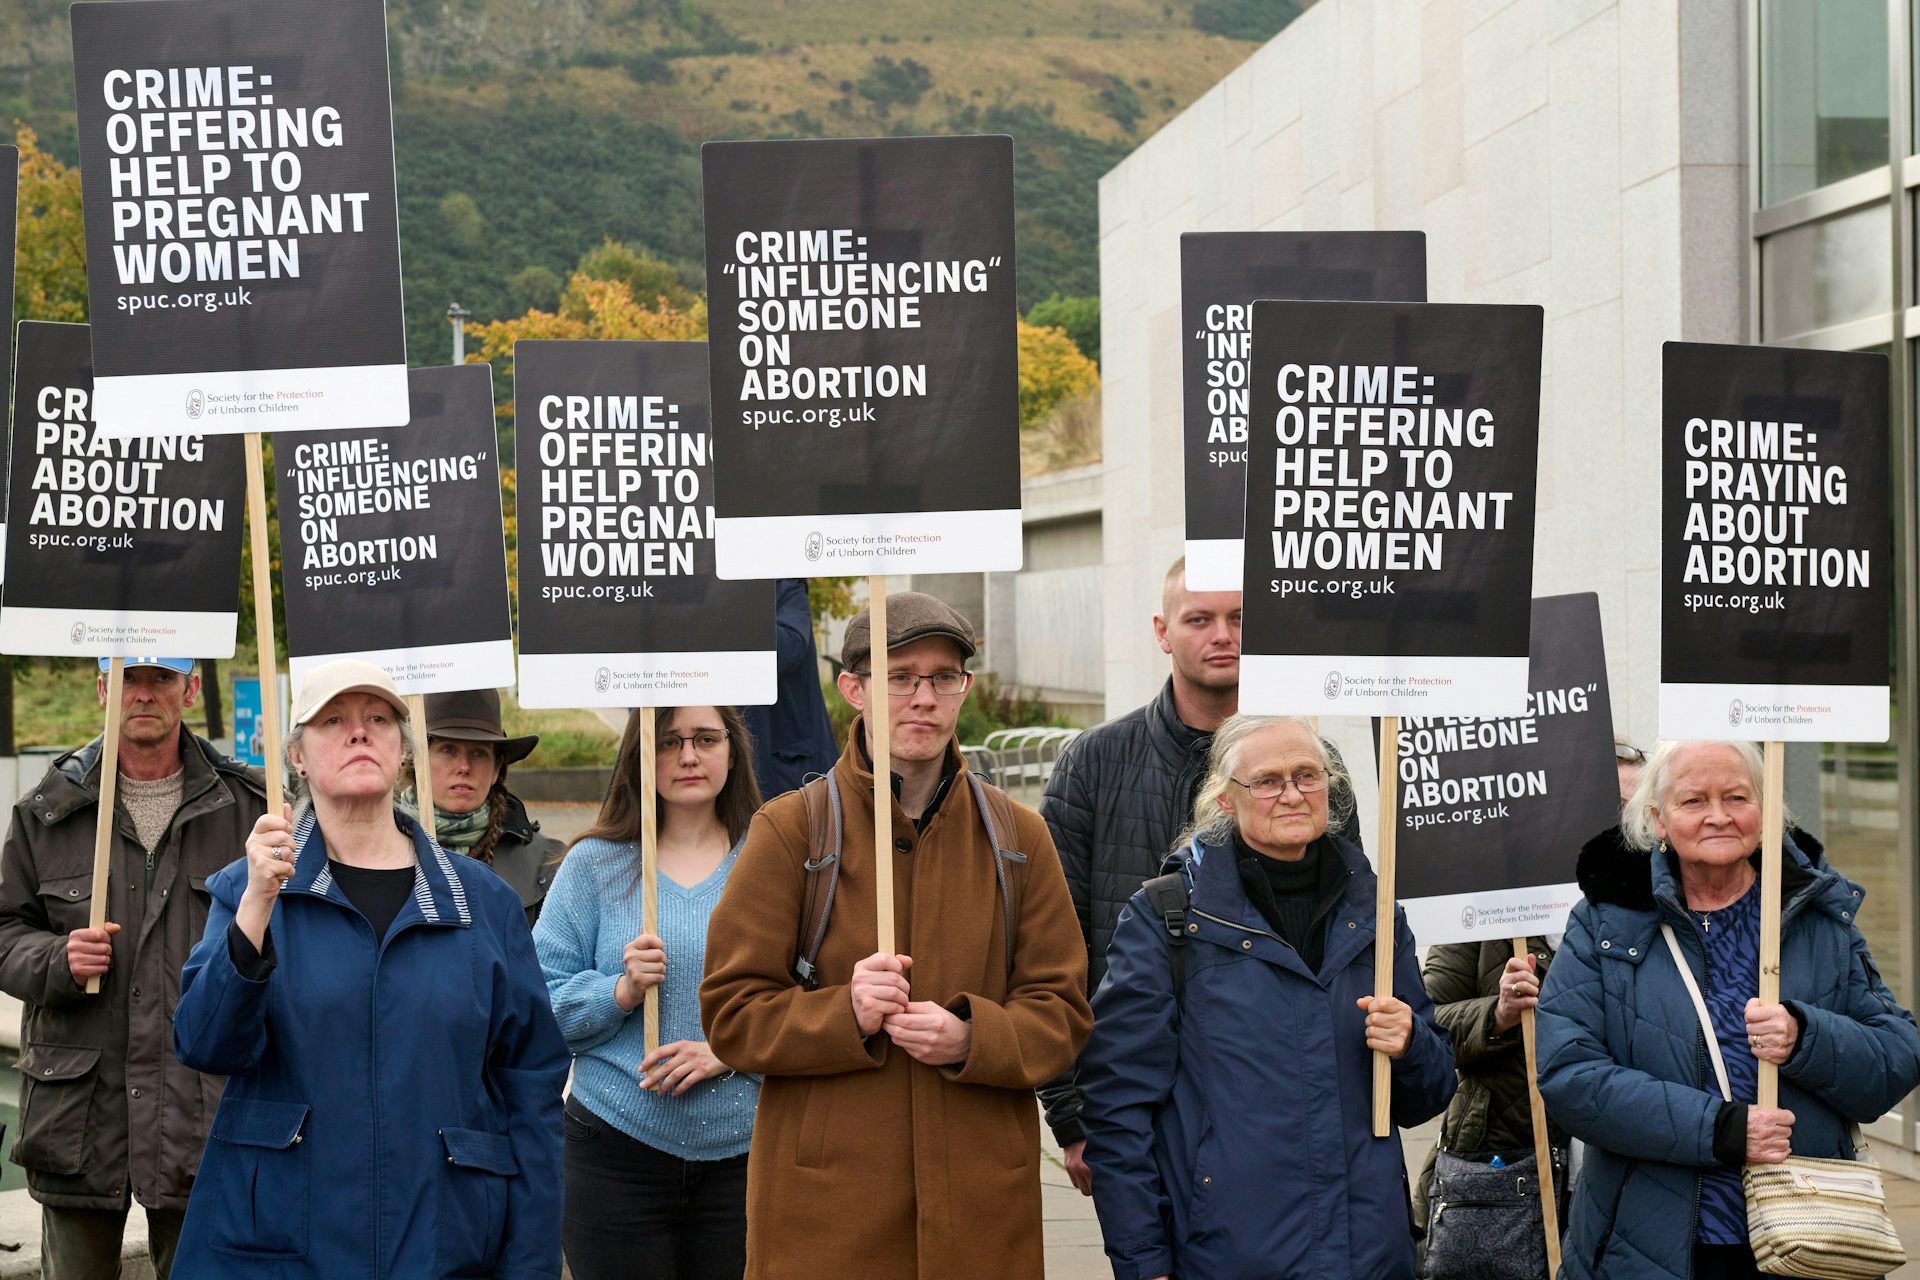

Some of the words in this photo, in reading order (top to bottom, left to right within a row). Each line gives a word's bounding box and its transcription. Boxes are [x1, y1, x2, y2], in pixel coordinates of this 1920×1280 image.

[104, 66, 273, 110] CRIME:
[106, 106, 343, 154] OFFERING
[110, 154, 231, 197] HELP
[243, 151, 301, 192] TO
[113, 193, 369, 241] PREGNANT
[113, 239, 299, 284] WOMEN
[736, 230, 867, 264] CRIME:
[118, 286, 252, 315] spuc.org.uk
[738, 297, 921, 333] SOMEONE
[740, 334, 790, 367] ON
[207, 393, 240, 403] Society
[244, 392, 256, 401] for
[260, 392, 274, 400] the
[276, 390, 323, 399] Protection
[740, 365, 926, 400] ABORTION
[1277, 364, 1434, 404] CRIME:
[208, 406, 217, 415] of
[220, 405, 256, 414] Unborn
[259, 403, 298, 412] Children
[539, 395, 678, 430] CRIME:
[743, 402, 876, 430] spuc.org.uk
[1276, 406, 1494, 447] OFFERING
[1685, 418, 1816, 461] CRIME:
[295, 438, 389, 469] CRIME:
[539, 432, 713, 467] OFFERIN
[32, 458, 163, 494] ABOUT
[1276, 448, 1388, 487] HELP
[1400, 450, 1452, 488] TO
[1686, 461, 1847, 505] PRAYING
[299, 485, 430, 519] SOMEONE
[542, 469, 641, 503] HELP
[652, 469, 699, 503] TO
[30, 493, 224, 531] ABORTION
[1274, 490, 1512, 529] PREGNANT
[1684, 503, 1809, 544] ABOUT
[30, 533, 133, 551] spuc.org.uk
[301, 518, 338, 544] ON
[827, 536, 859, 545] Society
[862, 535, 875, 544] for
[877, 535, 892, 543] the
[895, 533, 941, 543] Protection
[303, 535, 437, 569] ABORTION
[541, 542, 693, 577] WOMEN
[826, 548, 836, 557] of
[839, 548, 873, 557] Unborn
[877, 546, 916, 556] Children
[1272, 531, 1442, 570] WOMEN
[1683, 545, 1869, 587] ABORTION
[306, 565, 401, 590] spuc.org.uk
[542, 581, 653, 603] spuc.org.uk
[1271, 576, 1395, 599] spuc.org.uk
[1684, 591, 1784, 613] spuc.org.uk
[88, 626, 113, 635] Society
[140, 627, 176, 635] Protection
[407, 663, 417, 671] the
[420, 661, 454, 670] Protection
[407, 672, 436, 680] Children
[613, 671, 640, 679] Society
[670, 670, 708, 678] Protection
[1344, 677, 1375, 686] Society
[1378, 677, 1390, 685] for
[1392, 677, 1406, 685] the
[1408, 677, 1452, 685] Protection
[655, 681, 688, 689] Children
[1344, 688, 1353, 696] of
[1355, 689, 1388, 697] Unborn
[1391, 689, 1428, 697] Children
[1745, 704, 1770, 714] Society
[1772, 704, 1782, 712] for
[1784, 704, 1795, 712] the
[1796, 705, 1831, 713] Protection
[1745, 715, 1753, 723] of
[1754, 715, 1781, 724] Unborn
[1782, 715, 1813, 724] Children
[1398, 718, 1539, 756] SOMEONE
[1400, 755, 1439, 782] ON
[1403, 770, 1547, 808] ABORTION
[1406, 802, 1509, 830] spuc.org.uk
[1478, 908, 1504, 916] Society
[1506, 905, 1516, 913] for
[1532, 901, 1569, 910] Protection
[1479, 918, 1487, 926] of
[1489, 916, 1517, 925] Unborn
[1519, 913, 1550, 922] Children
